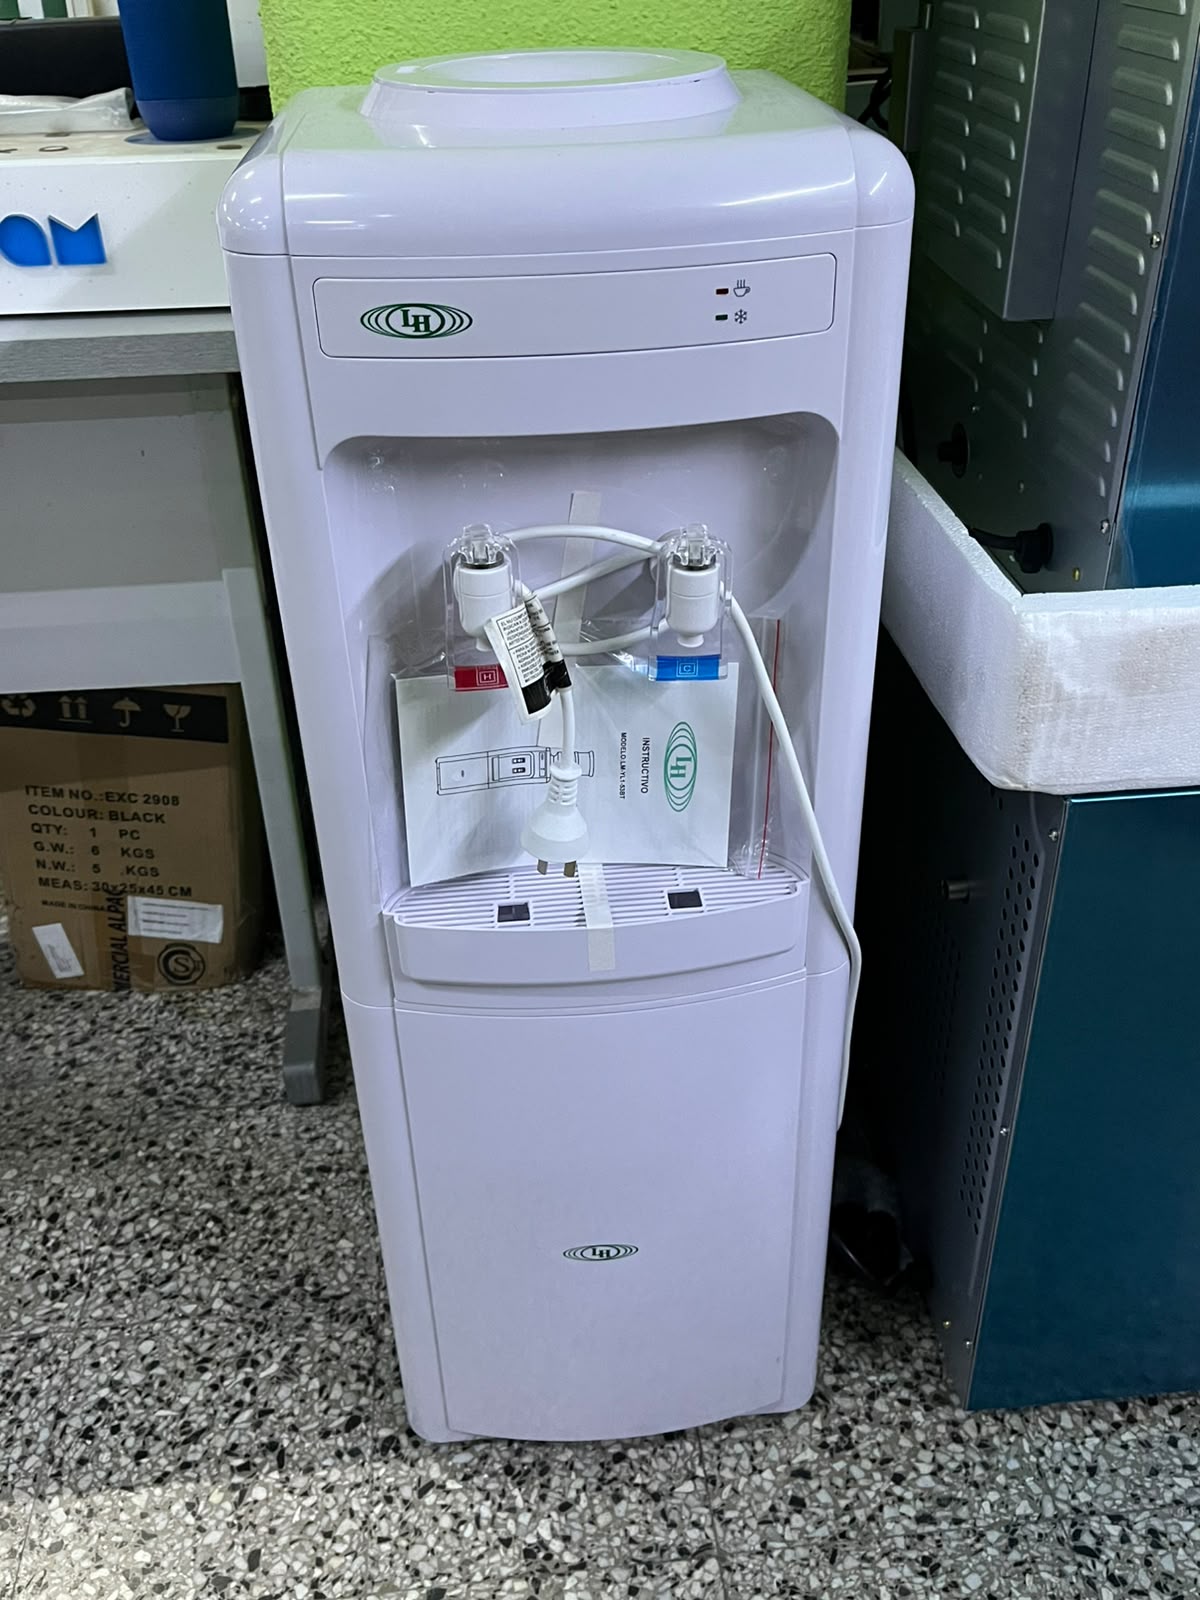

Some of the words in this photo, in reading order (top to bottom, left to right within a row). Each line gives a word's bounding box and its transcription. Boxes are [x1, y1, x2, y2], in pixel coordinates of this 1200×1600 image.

[400, 309, 432, 333] LH
[640, 737, 650, 794] INSTRUCTIVO
[670, 757, 692, 778] LH
[25, 785, 65, 798] ITEM
[143, 793, 180, 806] 2908
[28, 804, 103, 820] COLOUR:
[109, 810, 165, 824] BLACK
[31, 823, 68, 836] QTY:
[90, 827, 96, 837] 1
[119, 829, 140, 840] PC
[34, 841, 74, 854] G.W.:
[91, 845, 100, 856] 6
[121, 847, 155, 859] KGS
[36, 859, 76, 872] N.W.:
[92, 864, 101, 874] 5
[38, 877, 88, 891] MEAS:
[168, 886, 192, 897] CM
